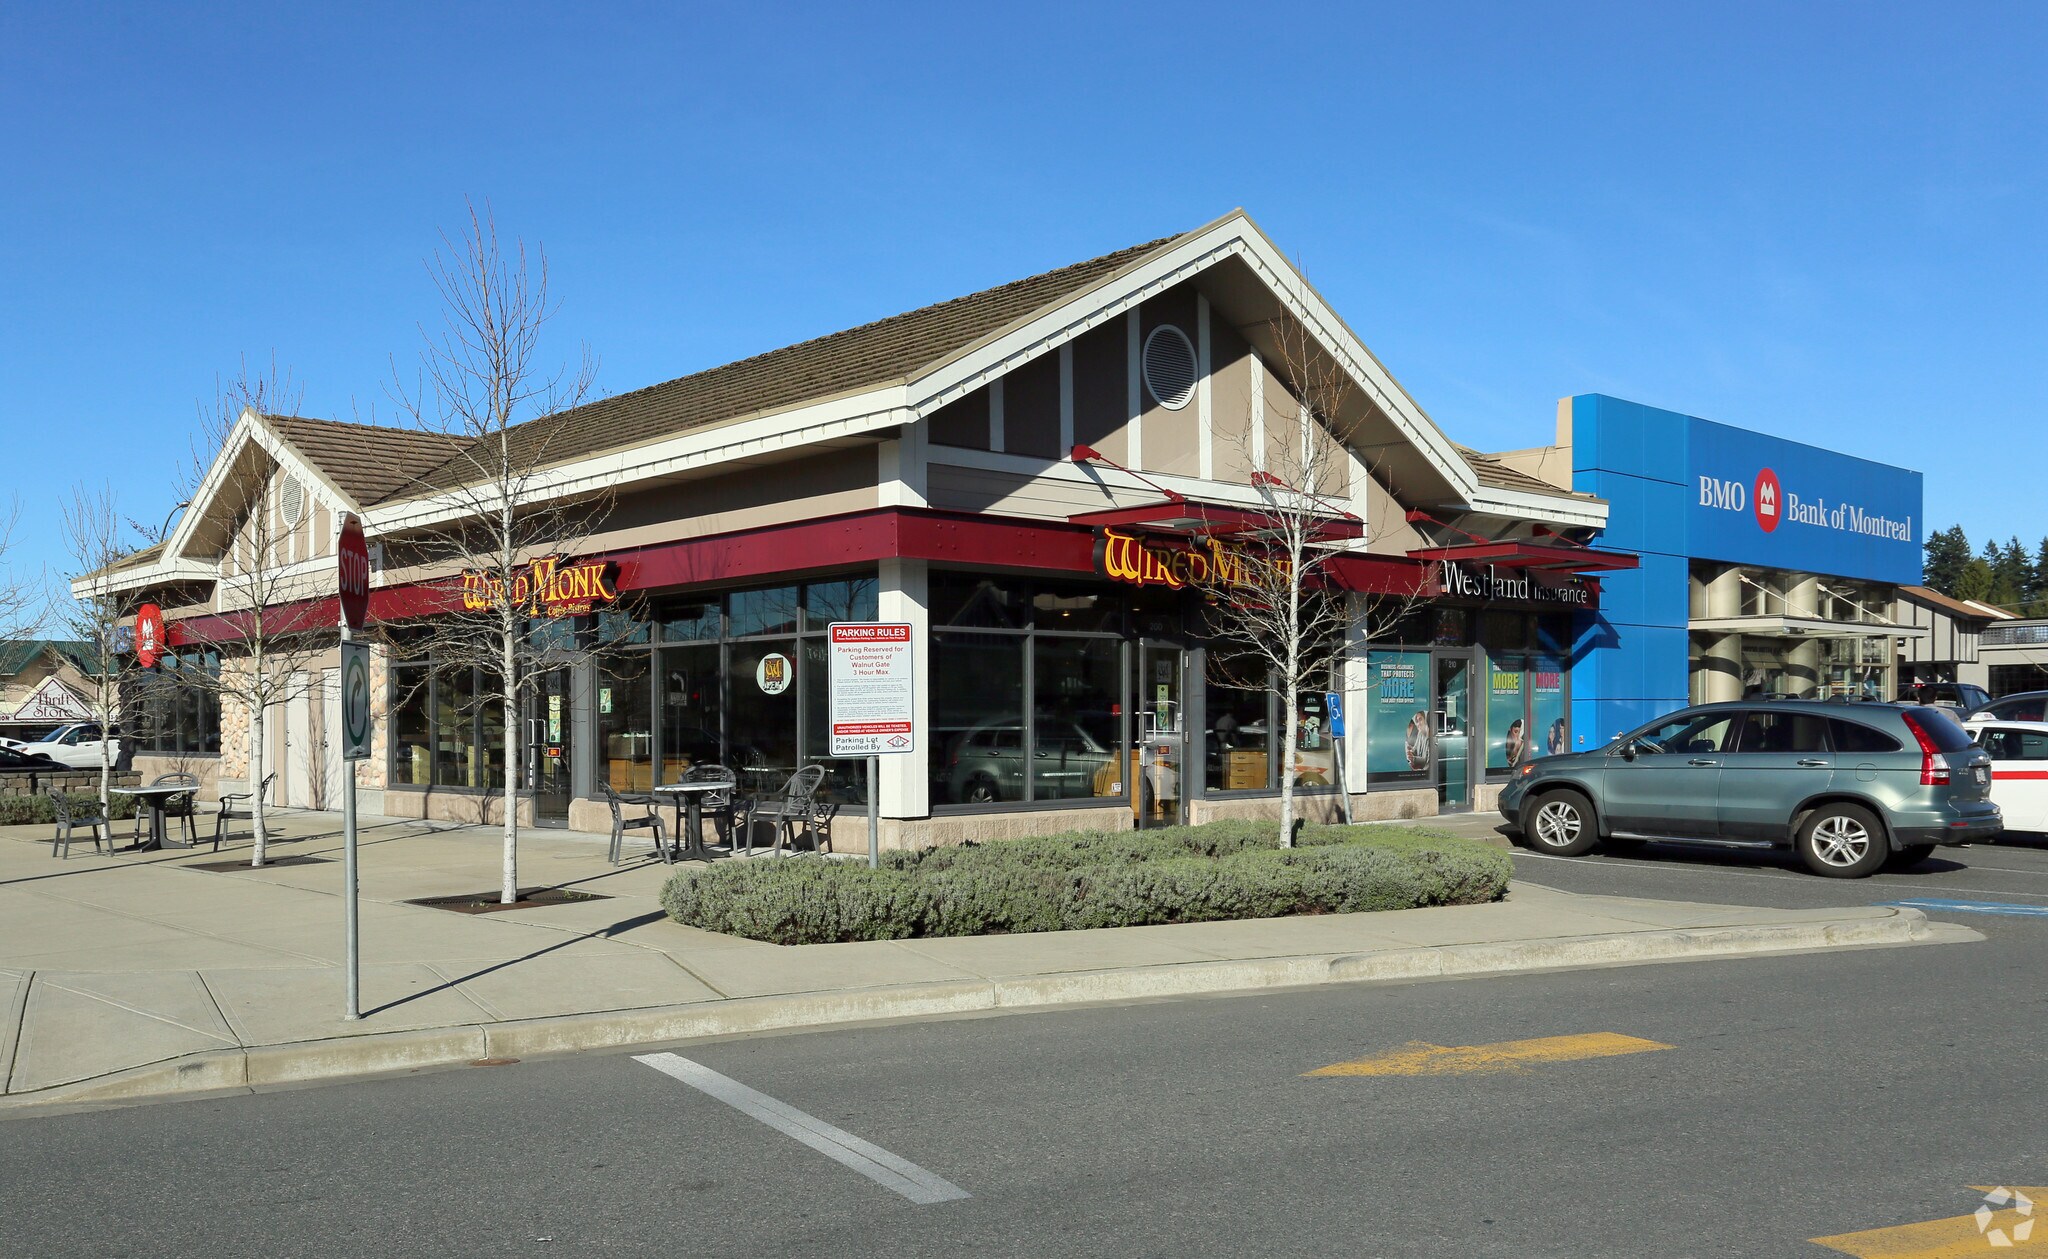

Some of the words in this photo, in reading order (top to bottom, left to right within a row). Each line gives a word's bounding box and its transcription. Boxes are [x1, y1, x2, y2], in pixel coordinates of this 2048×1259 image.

[1699, 475, 1745, 512] BMO
[1788, 493, 1828, 527] Bank
[1831, 503, 1846, 530] of
[1849, 505, 1911, 542] Montreal
[341, 547, 368, 597] STOP
[1443, 560, 1529, 601] Westland
[463, 571, 529, 611] WIRD
[530, 557, 615, 615] MONK
[836, 629, 875, 637] PARKING
[877, 628, 906, 637] RULES
[1381, 678, 1414, 698] MORE
[1493, 673, 1519, 689] MORE
[1536, 672, 1560, 688] MORE
[36, 692, 72, 706] Thrift
[33, 706, 74, 718] Store
